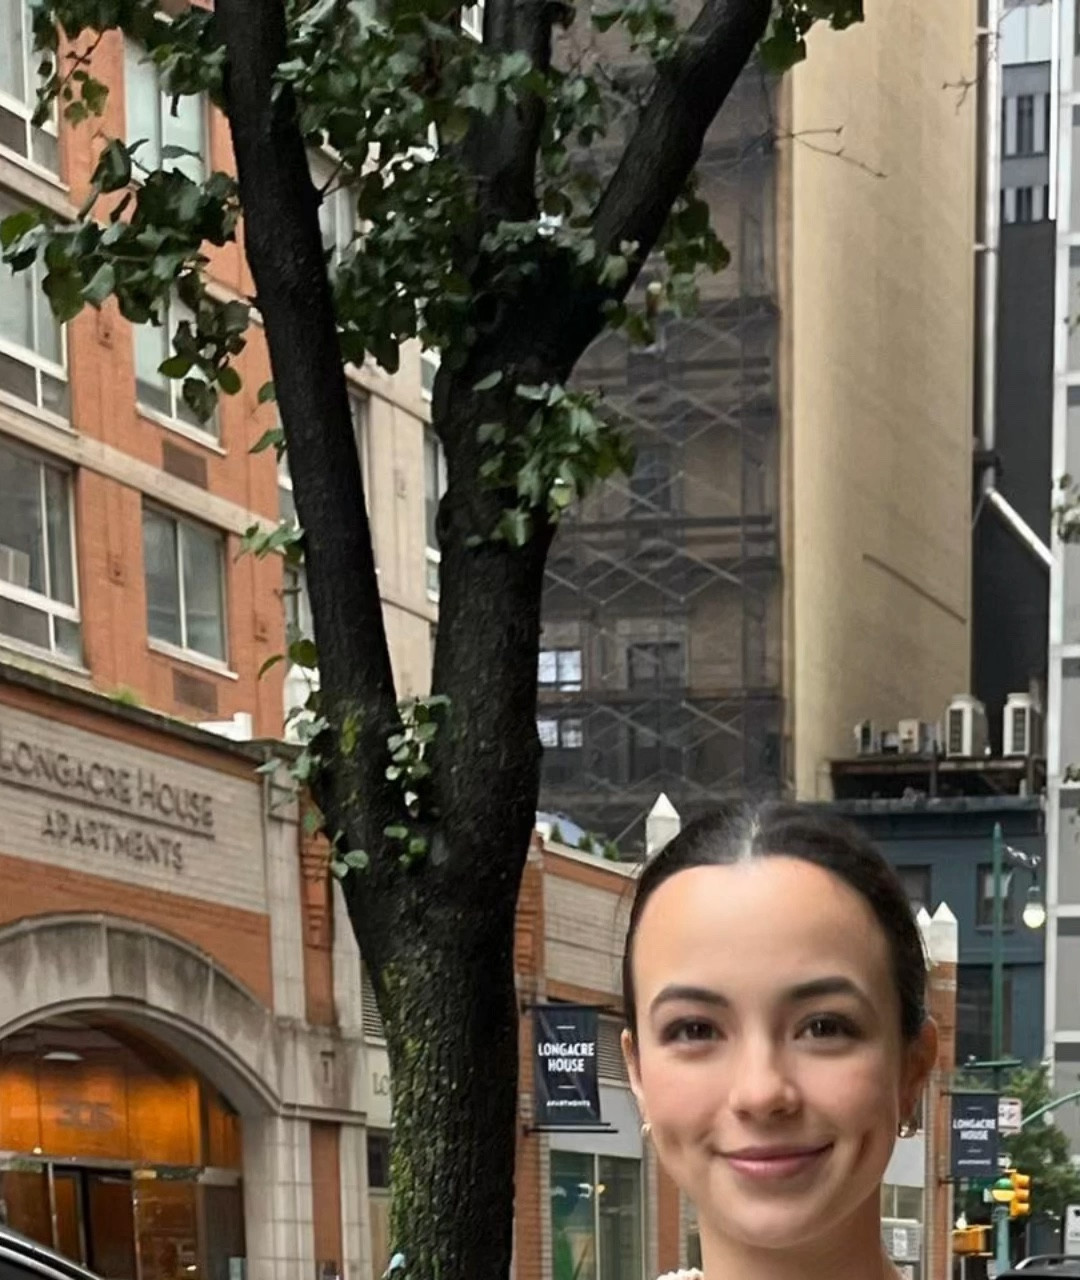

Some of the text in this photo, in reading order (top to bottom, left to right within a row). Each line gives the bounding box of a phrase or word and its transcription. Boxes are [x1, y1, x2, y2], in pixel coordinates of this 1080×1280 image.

[138, 767, 214, 827] HOUSE
[42, 809, 183, 871] APARTMENTS
[538, 1043, 595, 1056] LONGACRE
[548, 1059, 585, 1072] HOUSE
[953, 1119, 995, 1129] LONGACRE
